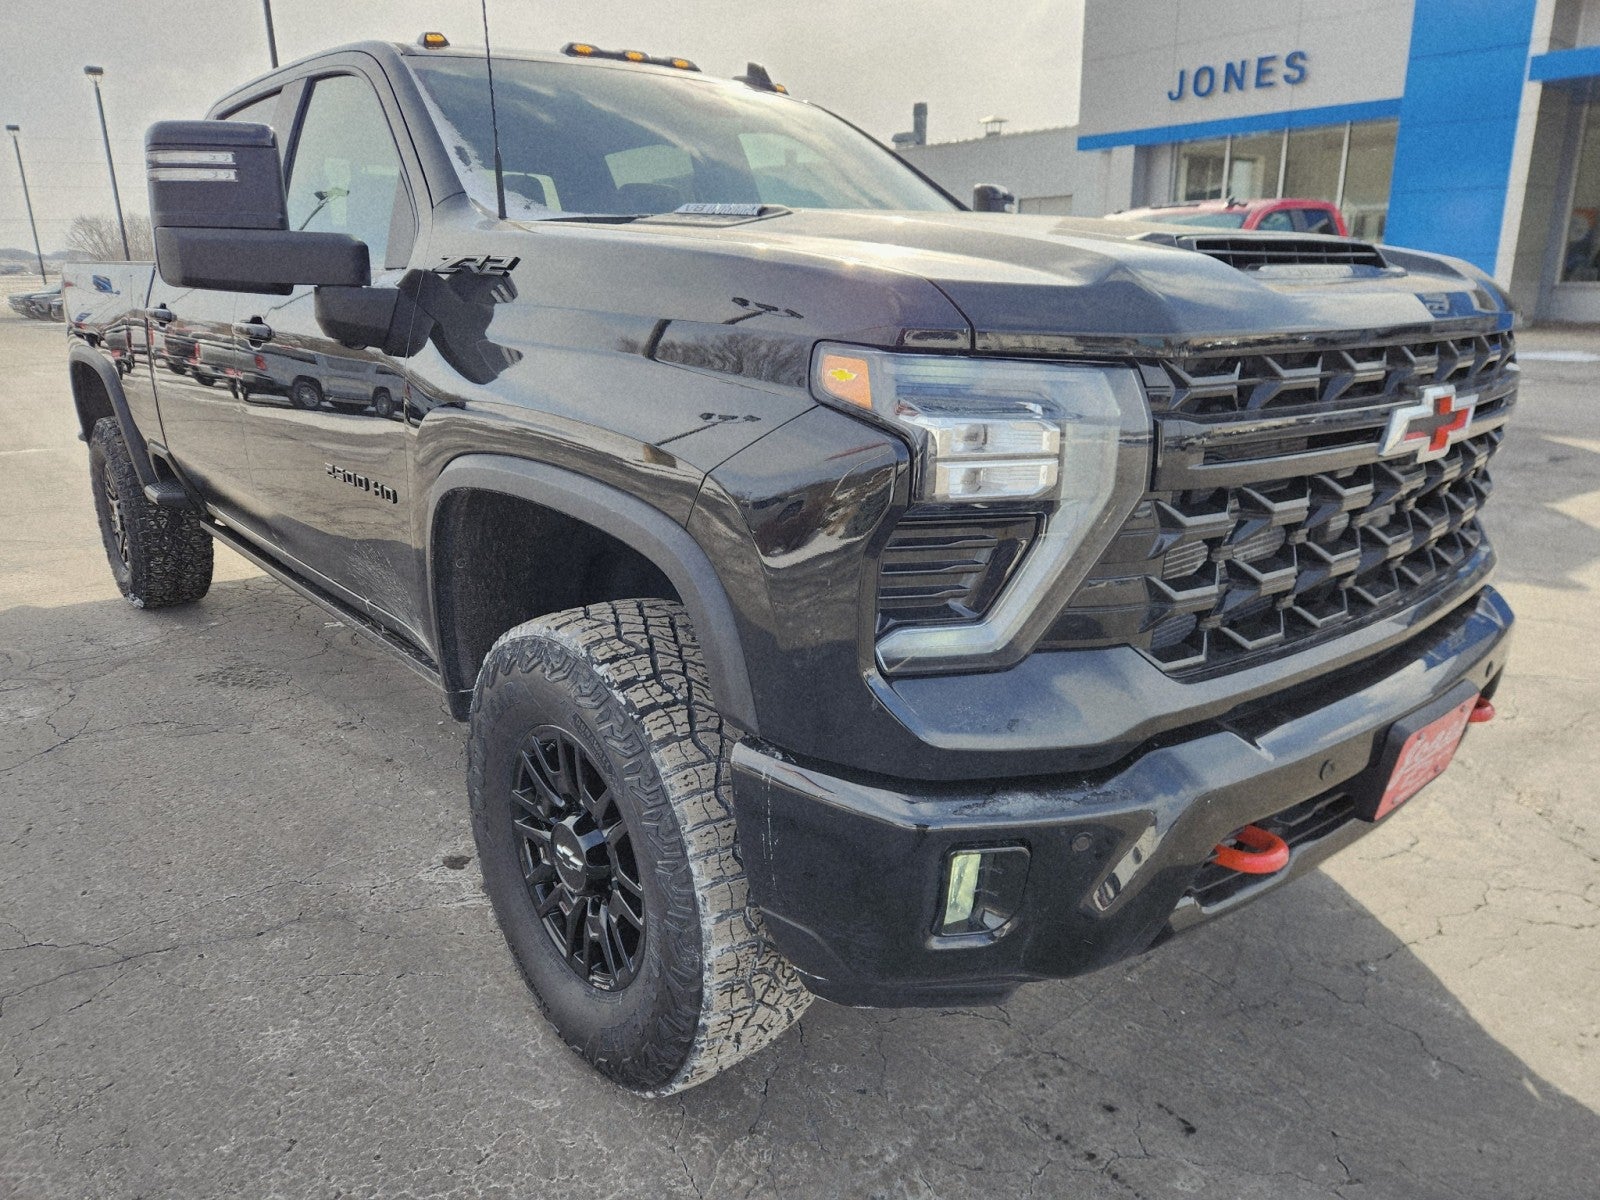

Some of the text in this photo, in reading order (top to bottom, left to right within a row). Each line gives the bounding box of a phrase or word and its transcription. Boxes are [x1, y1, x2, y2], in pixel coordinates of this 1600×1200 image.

[1167, 51, 1308, 101] JONES
[431, 255, 521, 277] ZR2
[371, 481, 398, 504] HD
